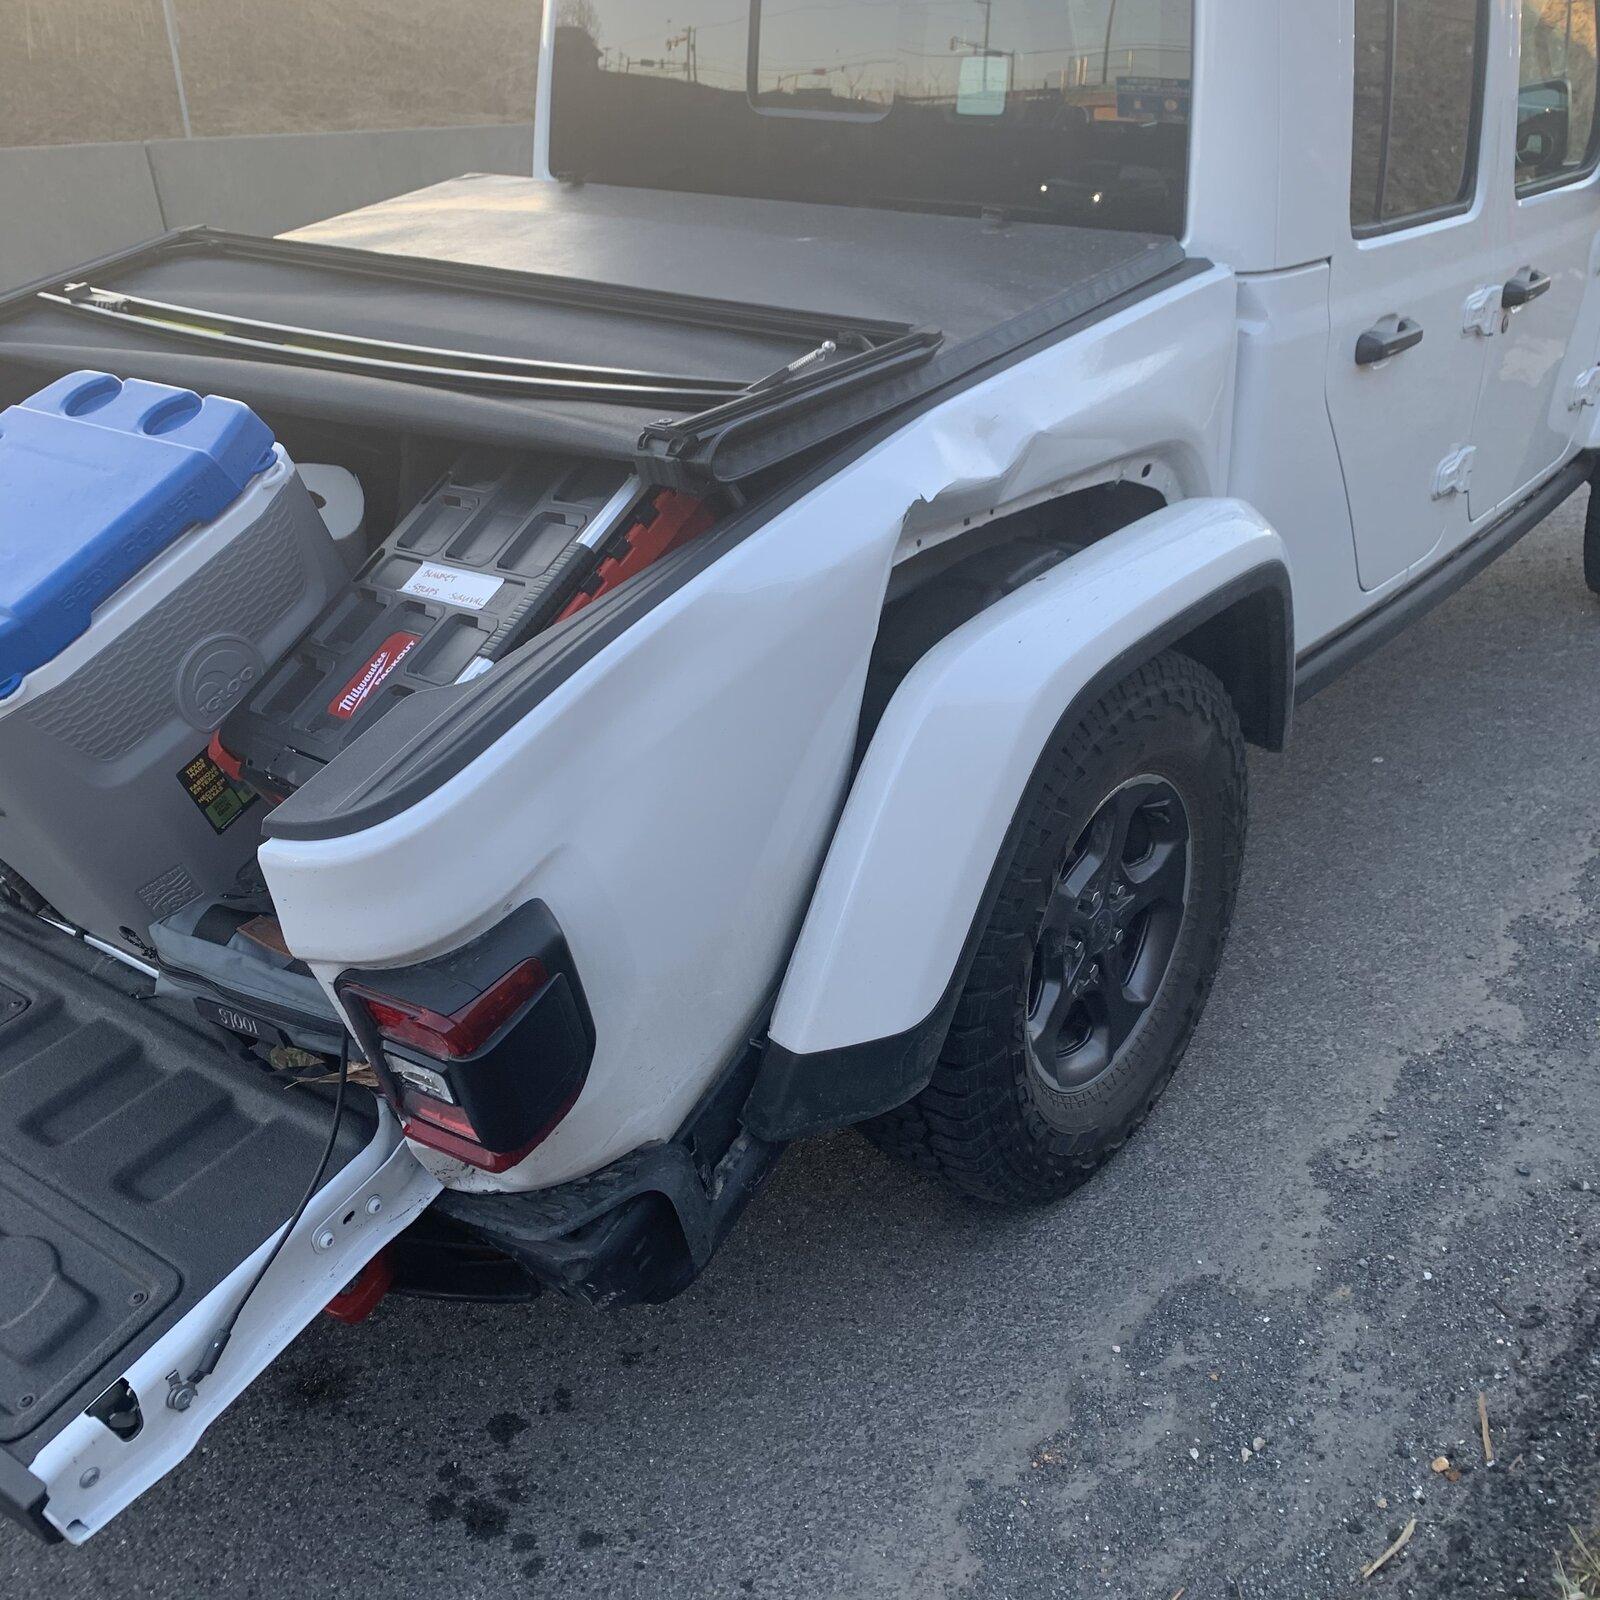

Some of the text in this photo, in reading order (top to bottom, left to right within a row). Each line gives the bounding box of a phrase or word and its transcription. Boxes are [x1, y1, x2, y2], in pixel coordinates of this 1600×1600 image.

[374, 640, 415, 686] PACKOUT
[338, 651, 388, 712] Milwaukee
[186, 758, 204, 775] TEXAS
[189, 762, 206, 778] MADE
[201, 771, 219, 787] TEXAS
[198, 785, 217, 803] HECHO
[205, 786, 223, 802] TEXAS
